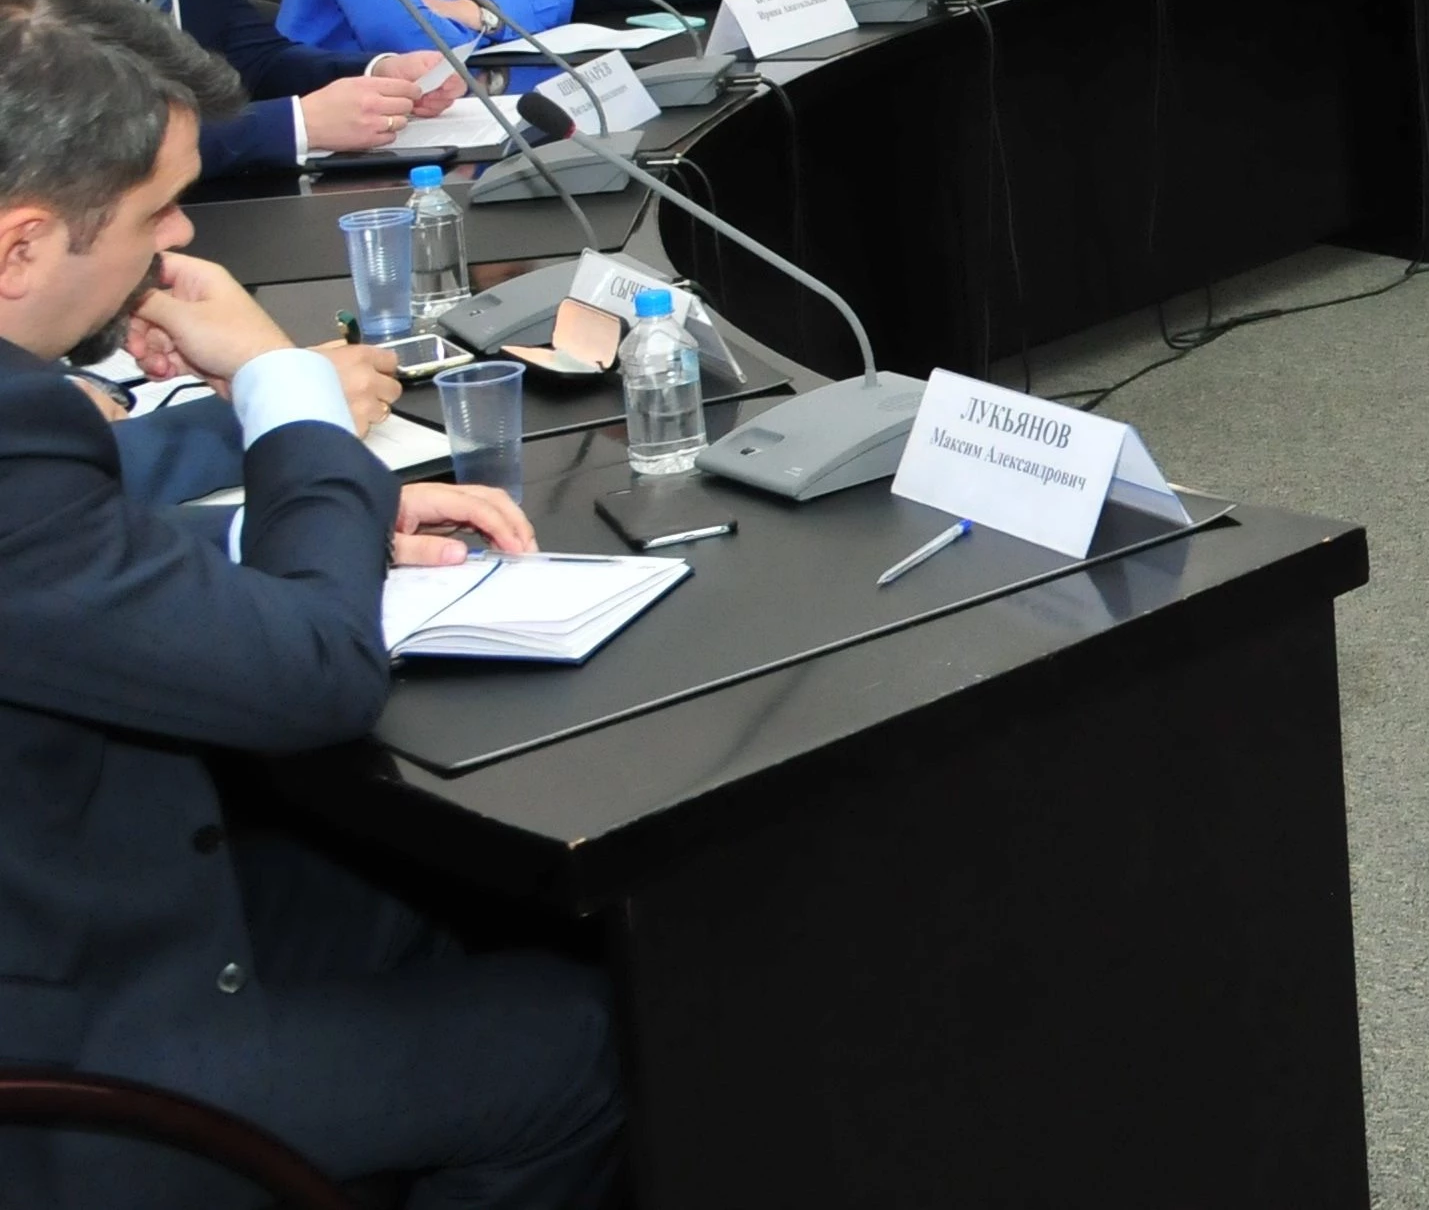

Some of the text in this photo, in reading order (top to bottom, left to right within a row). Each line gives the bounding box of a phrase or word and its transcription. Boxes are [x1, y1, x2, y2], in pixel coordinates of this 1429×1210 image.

[959, 396, 1073, 450] ЛУКЬЯНОВ
[929, 426, 1087, 492] Максим Александрович
